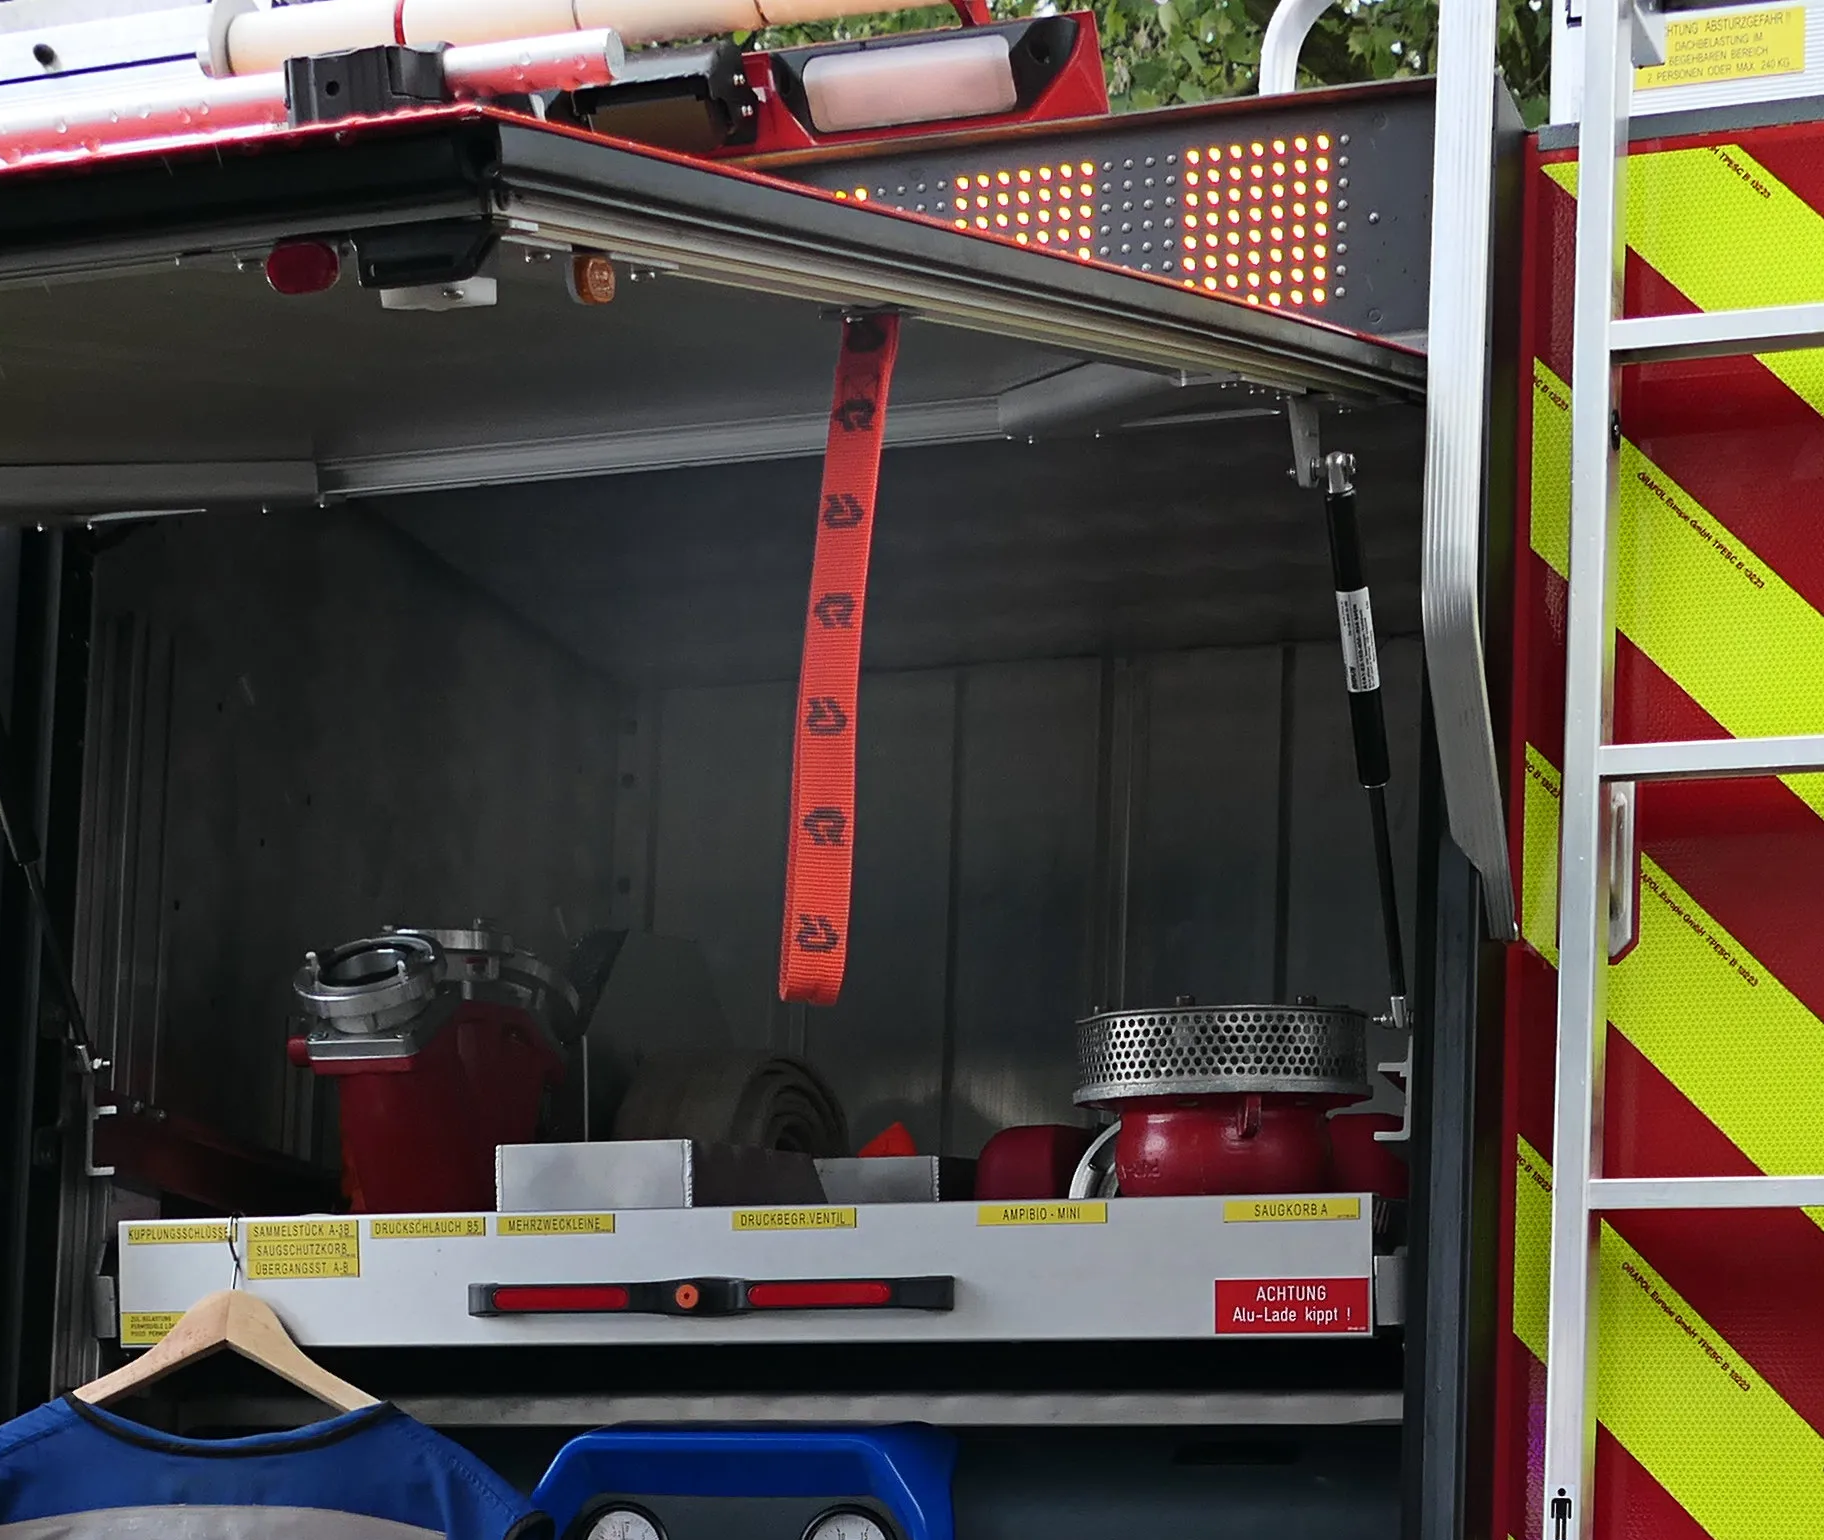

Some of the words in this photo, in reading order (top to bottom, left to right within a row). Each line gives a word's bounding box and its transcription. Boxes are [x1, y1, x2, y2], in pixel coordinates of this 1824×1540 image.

[1666, 22, 1698, 36] HTUNG
[1705, 12, 1783, 32] ABSTURZGEFAHR
[1675, 34, 1748, 52] DACHBELASTUNG
[1731, 47, 1768, 59] BEREICH
[1656, 67, 1703, 82] PERSONEN
[1708, 65, 1731, 75] ODER
[1002, 1208, 1046, 1221] AMPIBIO
[1058, 1207, 1081, 1219] MINI
[1254, 1203, 1317, 1217] SAUGKORB
[1321, 1203, 1328, 1215] A
[253, 1222, 324, 1237] SAMMELSTÜCK
[375, 1221, 461, 1235] DRUCKSCHLAUCH
[508, 1217, 600, 1232] MEHRZWECKLEINE
[256, 1242, 347, 1256] SAUGSCHUTZKORB
[333, 1261, 349, 1274] A-B
[1256, 1286, 1326, 1301] ACHTUNG
[1232, 1306, 1297, 1322] Alu-Lade
[1305, 1306, 1338, 1324] kippt
[1347, 1308, 1351, 1320] !
